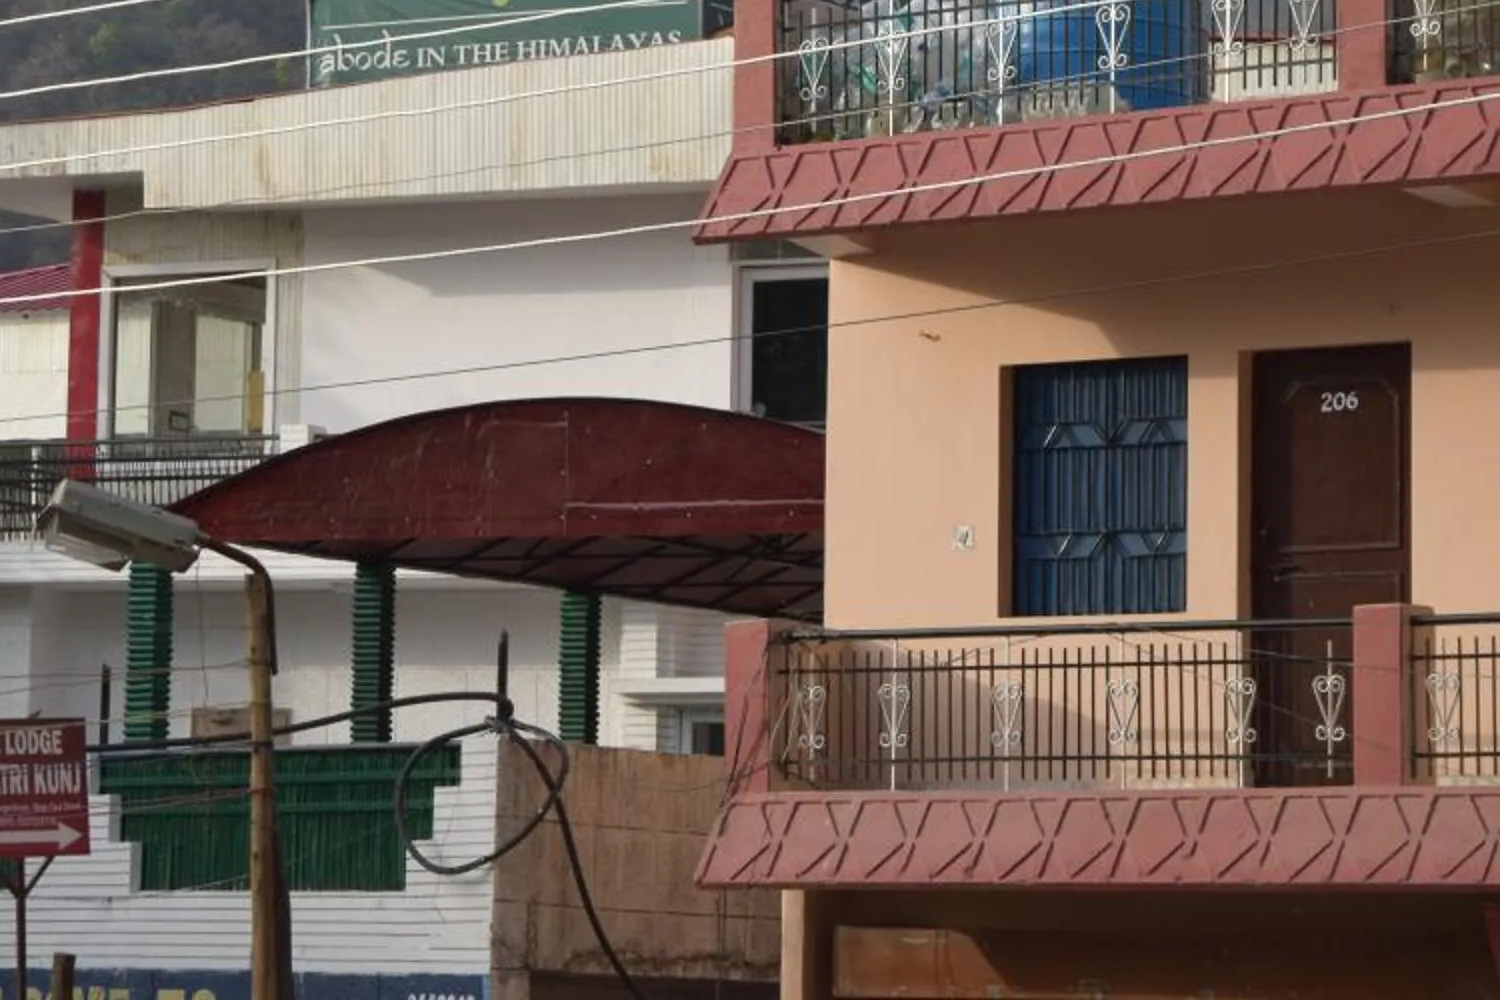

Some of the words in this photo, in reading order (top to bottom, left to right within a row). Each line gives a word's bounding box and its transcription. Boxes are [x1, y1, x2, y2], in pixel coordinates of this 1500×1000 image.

[318, 29, 411, 76] abode
[416, 45, 447, 70] IN
[452, 40, 510, 66] THE
[1320, 391, 1359, 413] 206
[5, 728, 63, 755] LODGE
[34, 761, 82, 795] KUNJ
